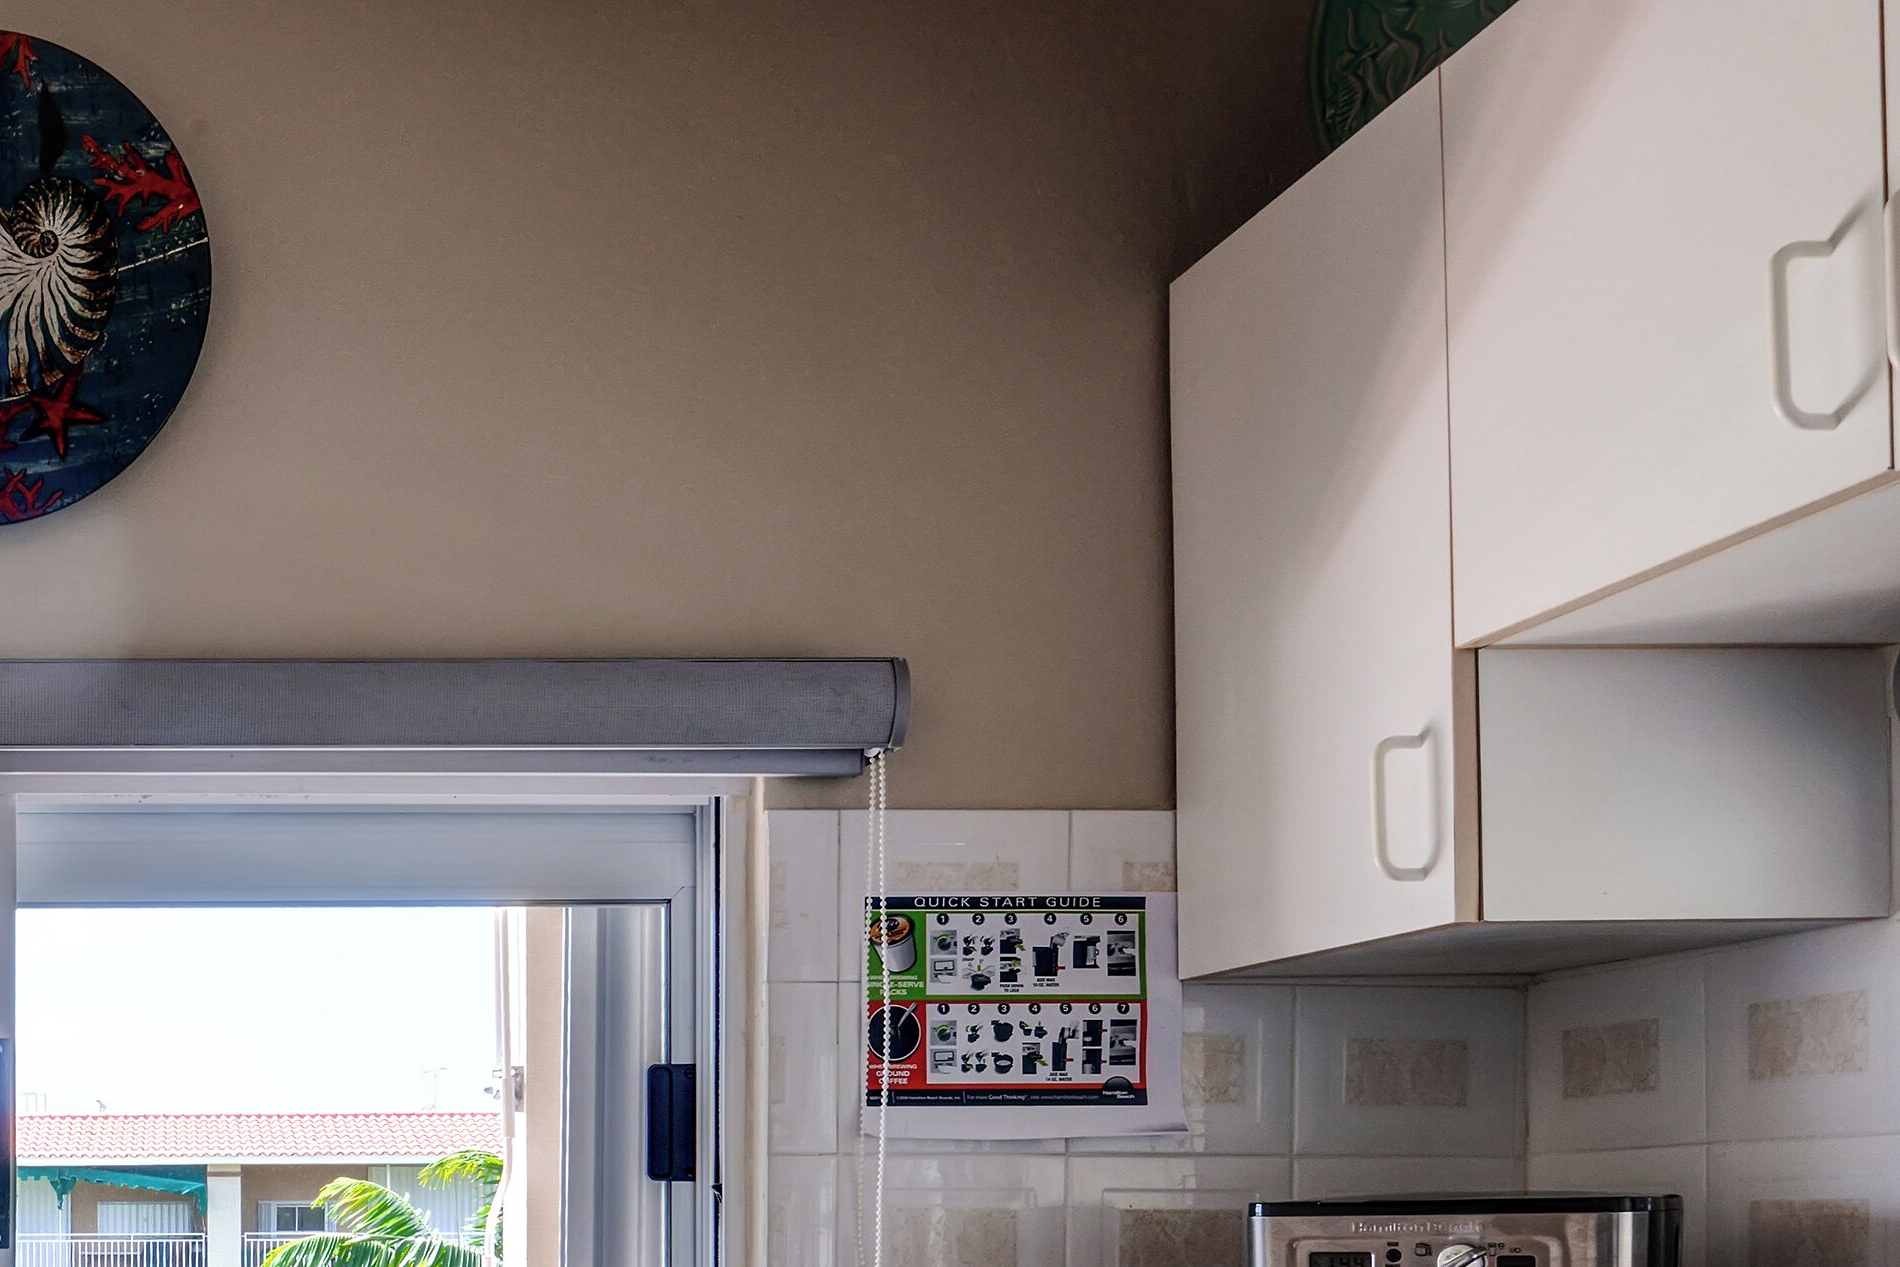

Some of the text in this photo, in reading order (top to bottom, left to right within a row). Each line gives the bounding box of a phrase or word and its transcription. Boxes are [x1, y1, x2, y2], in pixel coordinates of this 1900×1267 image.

[914, 897, 1101, 908] QUICK START GUIDE
